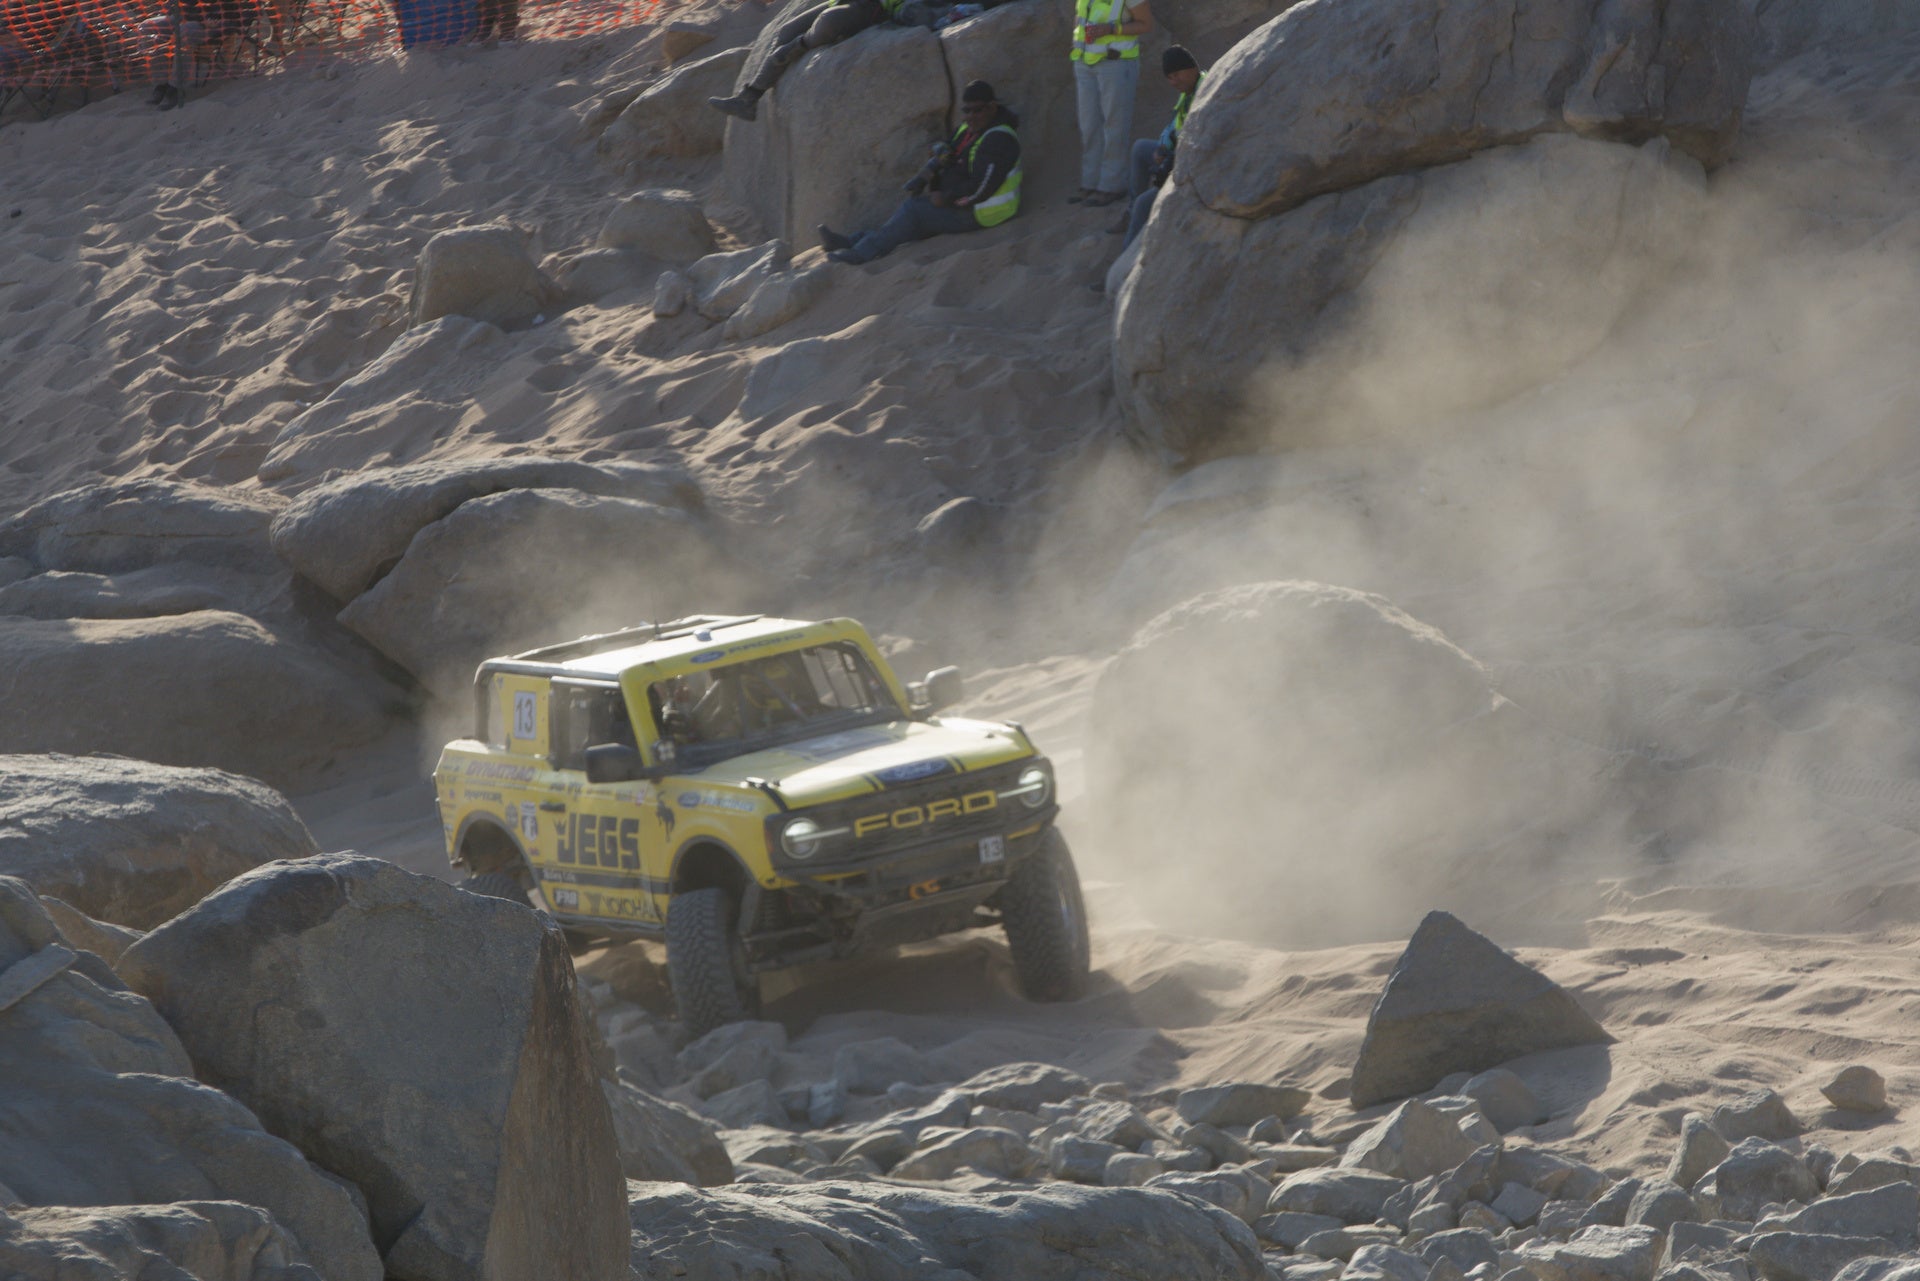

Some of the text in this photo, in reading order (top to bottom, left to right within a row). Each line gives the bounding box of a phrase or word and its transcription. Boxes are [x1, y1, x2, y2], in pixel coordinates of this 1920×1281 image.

[515, 697, 533, 734] 13
[854, 789, 998, 839] FORD
[556, 812, 641, 871] JEGS
